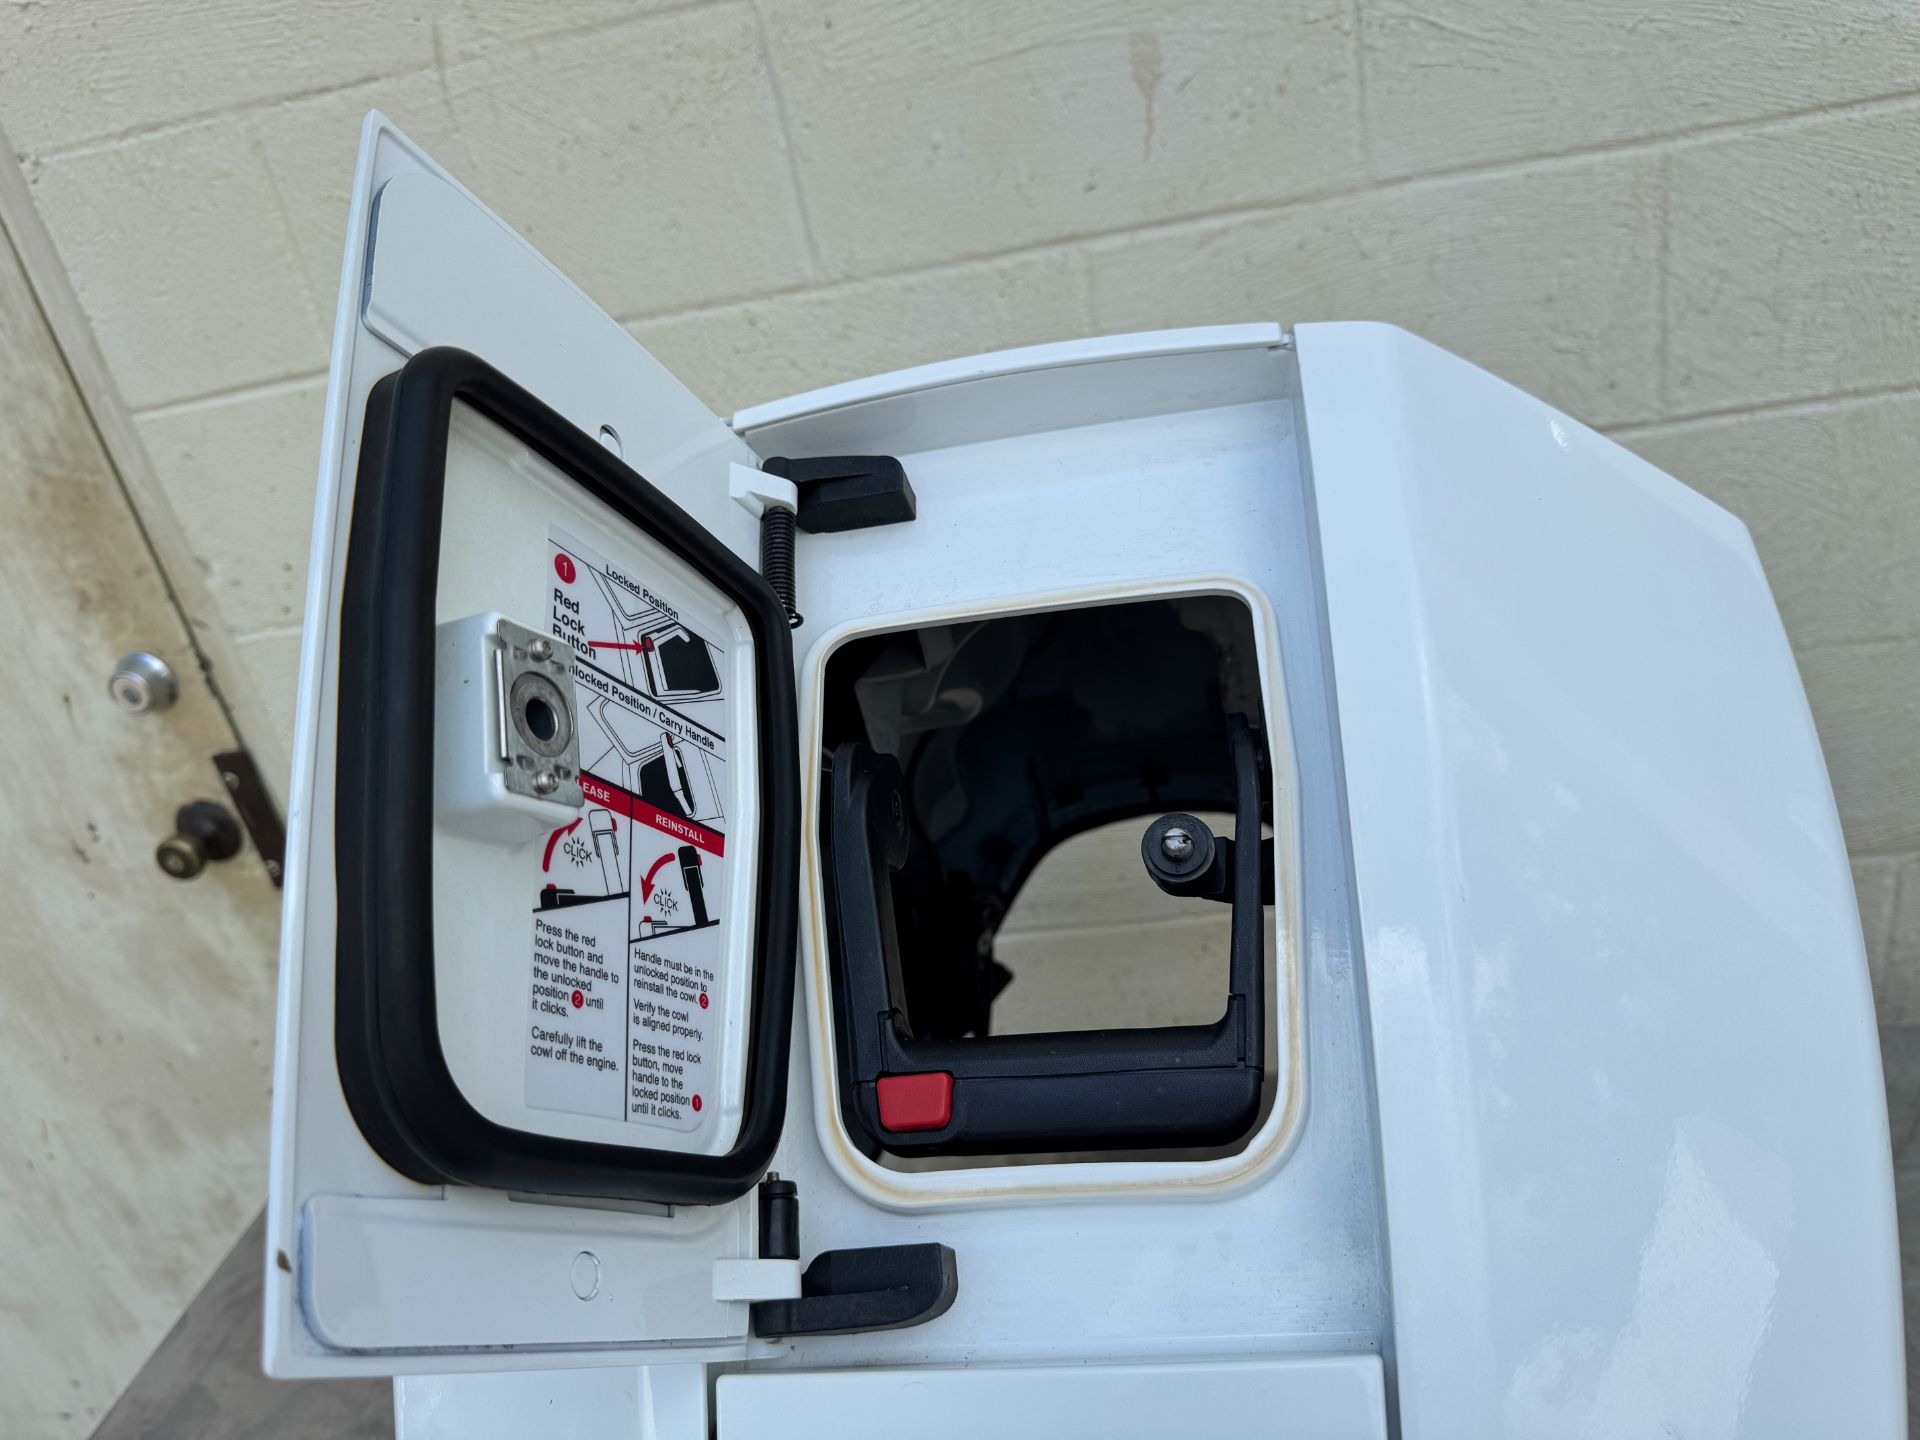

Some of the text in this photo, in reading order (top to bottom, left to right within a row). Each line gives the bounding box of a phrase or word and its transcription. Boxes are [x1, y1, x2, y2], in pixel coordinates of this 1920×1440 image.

[554, 588, 580, 615] Red
[605, 564, 679, 620] Locked Position
[553, 606, 586, 636] Lock
[612, 687, 651, 716] Position
[652, 708, 658, 719] /
[659, 712, 684, 734] Carry
[685, 727, 715, 750] Handle
[655, 813, 705, 843] REINSTALL
[563, 842, 593, 863] CLICK
[653, 893, 678, 912] CLICK
[536, 919, 596, 947] Press the red
[534, 934, 603, 964] lock button and
[534, 952, 619, 984] move the handle to
[634, 947, 714, 982] Handle must be in the
[533, 966, 592, 991] the unlocked
[633, 978, 664, 995] reinstall
[666, 986, 678, 998] the
[679, 991, 698, 1004] cowl.
[634, 964, 708, 993] unlocked position to
[532, 997, 569, 1017] it clicks.
[533, 984, 569, 1001] position
[586, 996, 603, 1010] until
[633, 998, 689, 1023] Verify the cowl
[531, 1026, 603, 1052] Carefully lift the
[633, 1013, 704, 1042] is aligned properly.
[531, 1045, 618, 1071] cowl off the engine.
[632, 1054, 683, 1075] button, move
[633, 1039, 702, 1064] Press the red lock
[632, 1069, 683, 1090] handle to the
[632, 1085, 659, 1101] locked
[660, 1092, 690, 1106] position
[632, 1103, 682, 1120] until it clicks.
